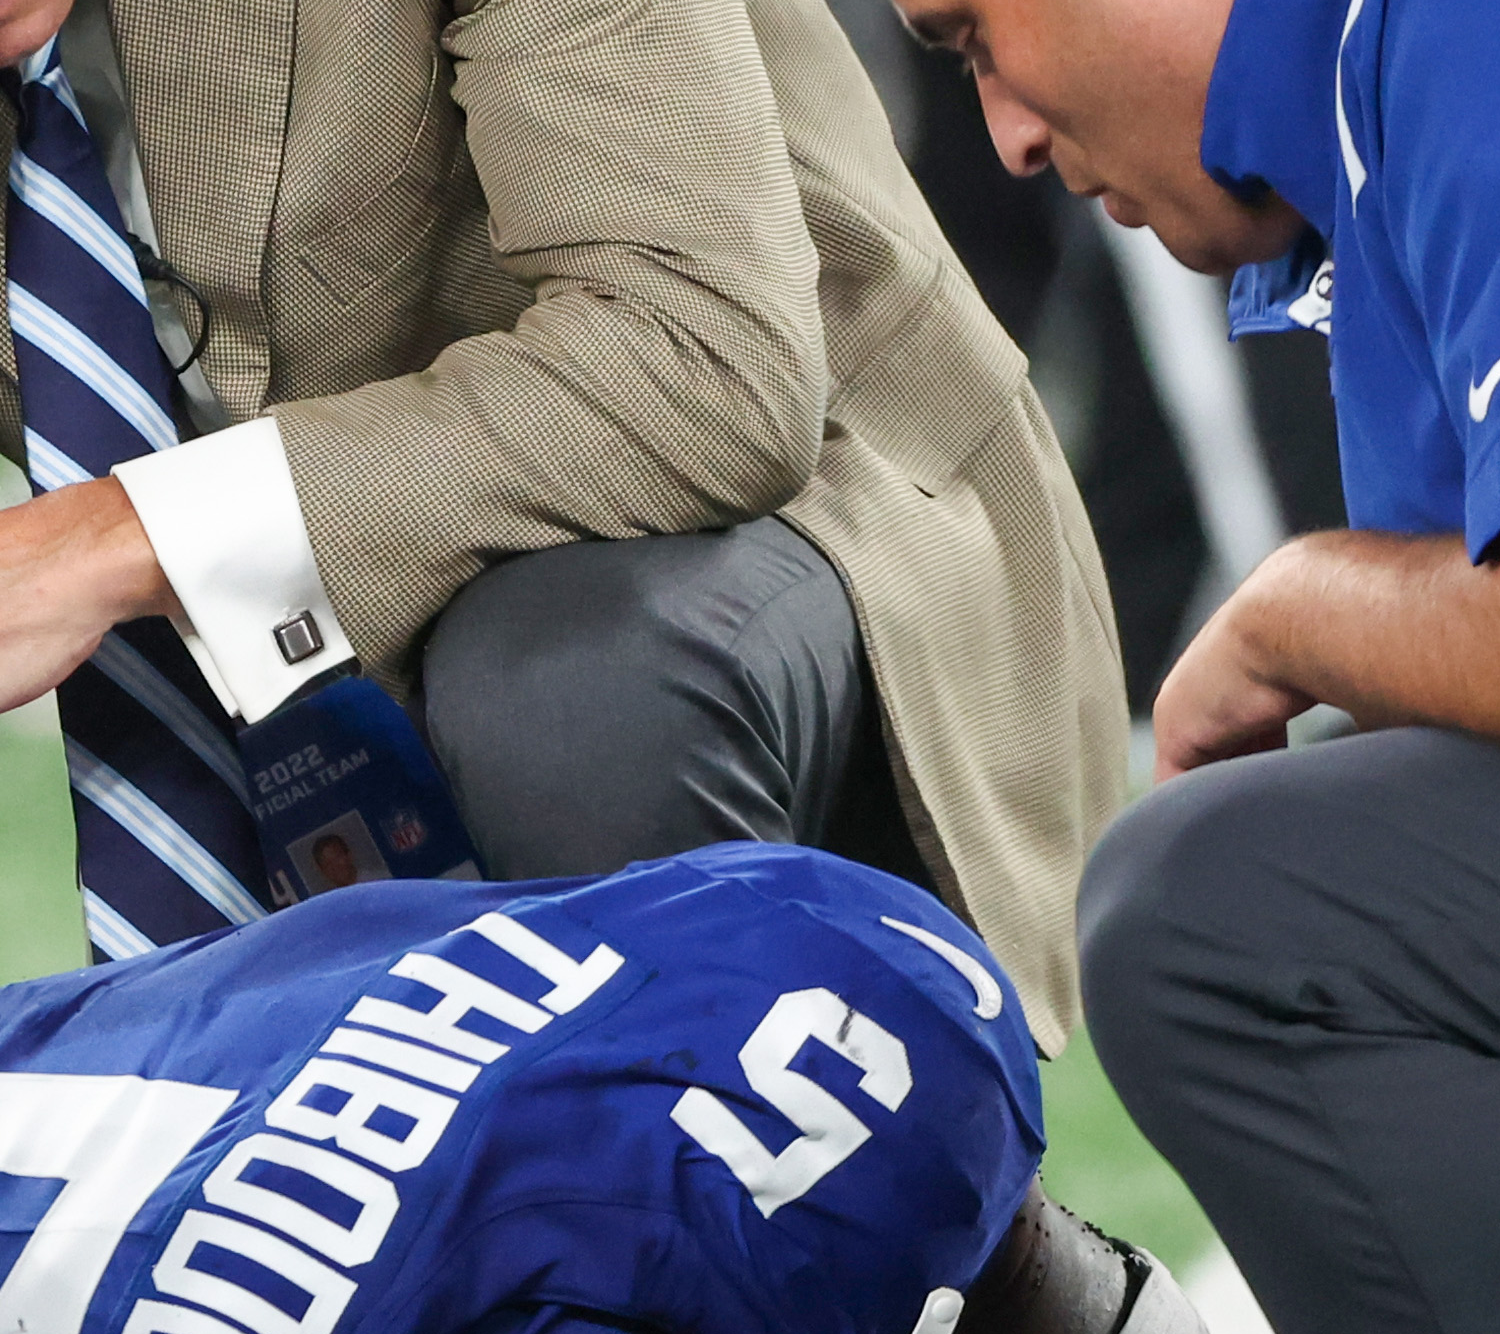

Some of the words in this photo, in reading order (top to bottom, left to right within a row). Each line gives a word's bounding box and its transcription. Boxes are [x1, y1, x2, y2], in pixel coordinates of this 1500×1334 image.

[254, 743, 324, 794] 2022
[254, 780, 315, 822] FICIAL
[315, 747, 370, 786] TEAM
[669, 987, 913, 1219] 5
